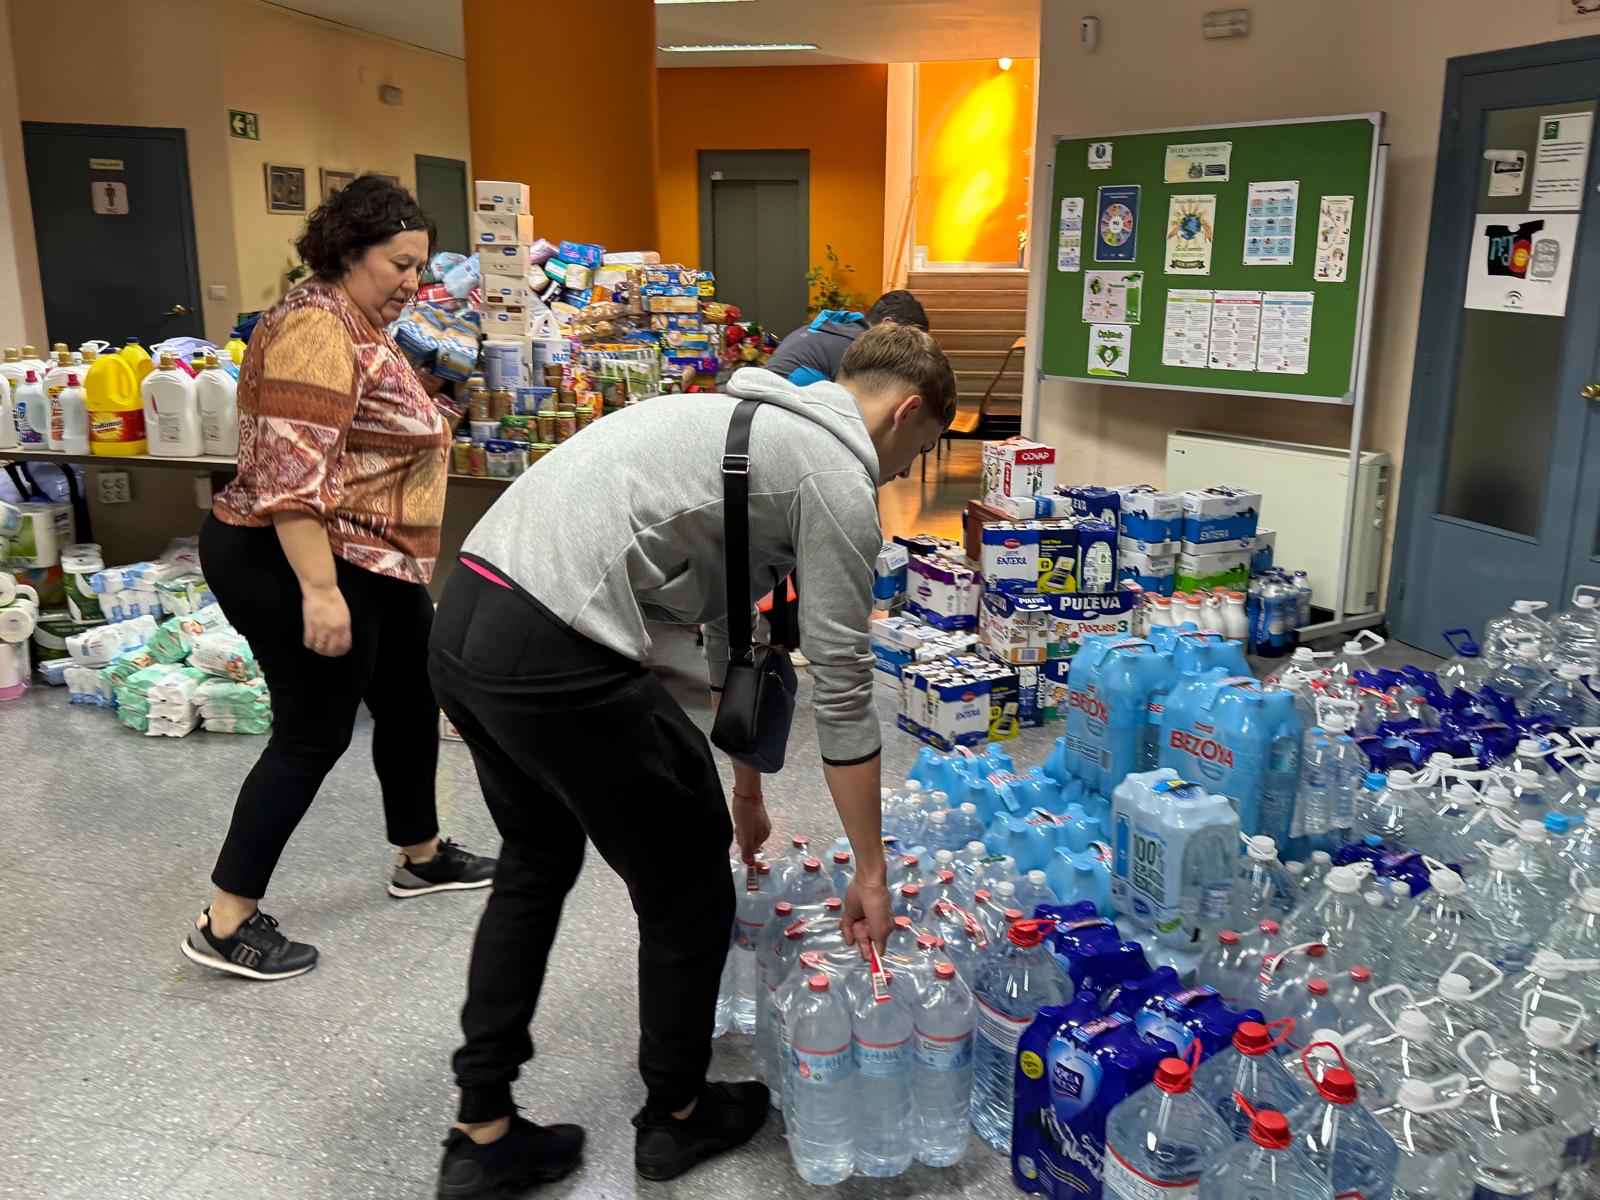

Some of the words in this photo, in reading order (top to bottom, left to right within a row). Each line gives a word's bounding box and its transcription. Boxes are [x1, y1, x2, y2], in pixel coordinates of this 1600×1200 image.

[1059, 596, 1121, 611] PULEVA
[1077, 622, 1116, 634] Peques
[1117, 620, 1129, 633] 3
[1170, 729, 1235, 769] BEZOYA
